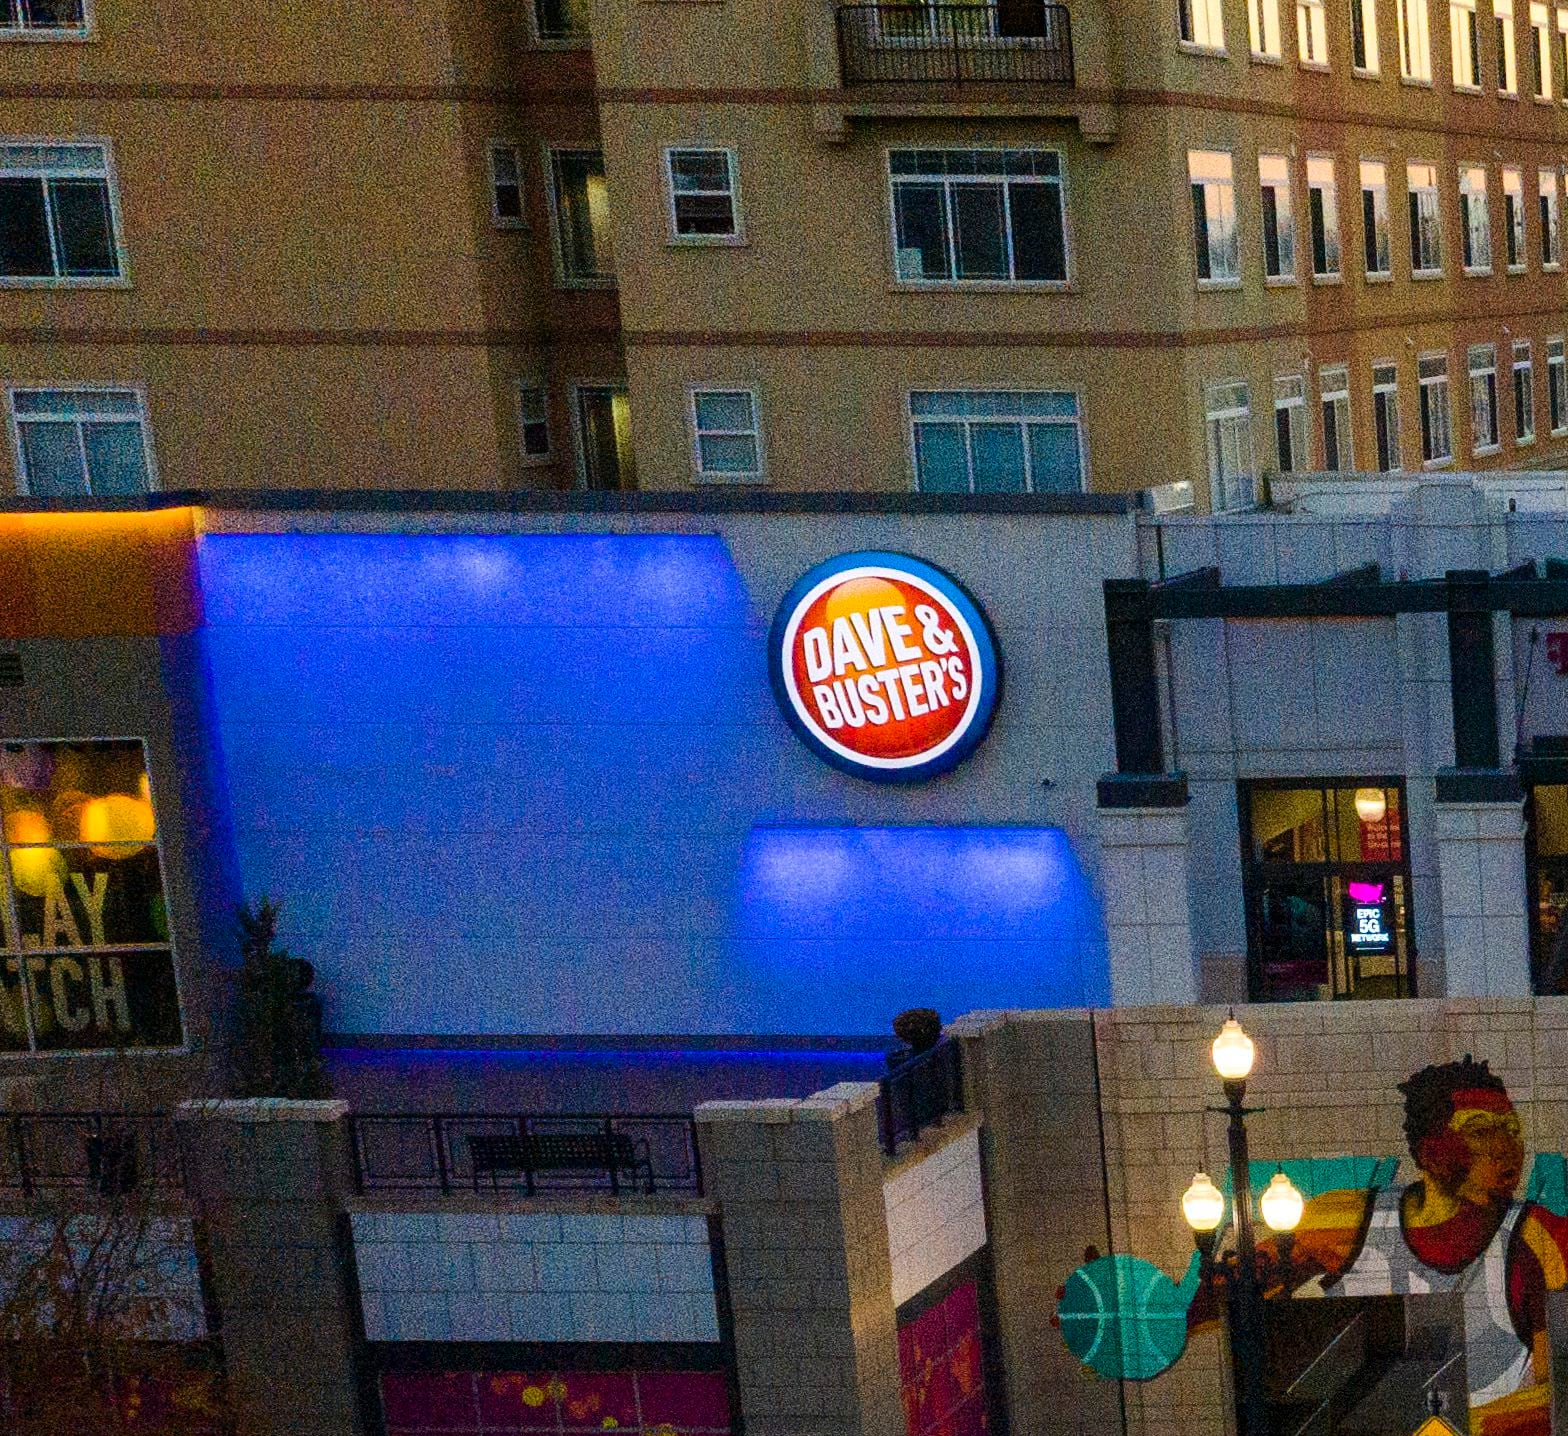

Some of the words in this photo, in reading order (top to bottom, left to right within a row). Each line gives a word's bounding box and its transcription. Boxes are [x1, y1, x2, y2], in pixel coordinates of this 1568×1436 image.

[803, 605, 923, 683] DAVE
[914, 604, 959, 655] &
[812, 655, 968, 729] BUSTER'S
[1357, 909, 1381, 919] EPIC
[1359, 919, 1381, 934] 5G
